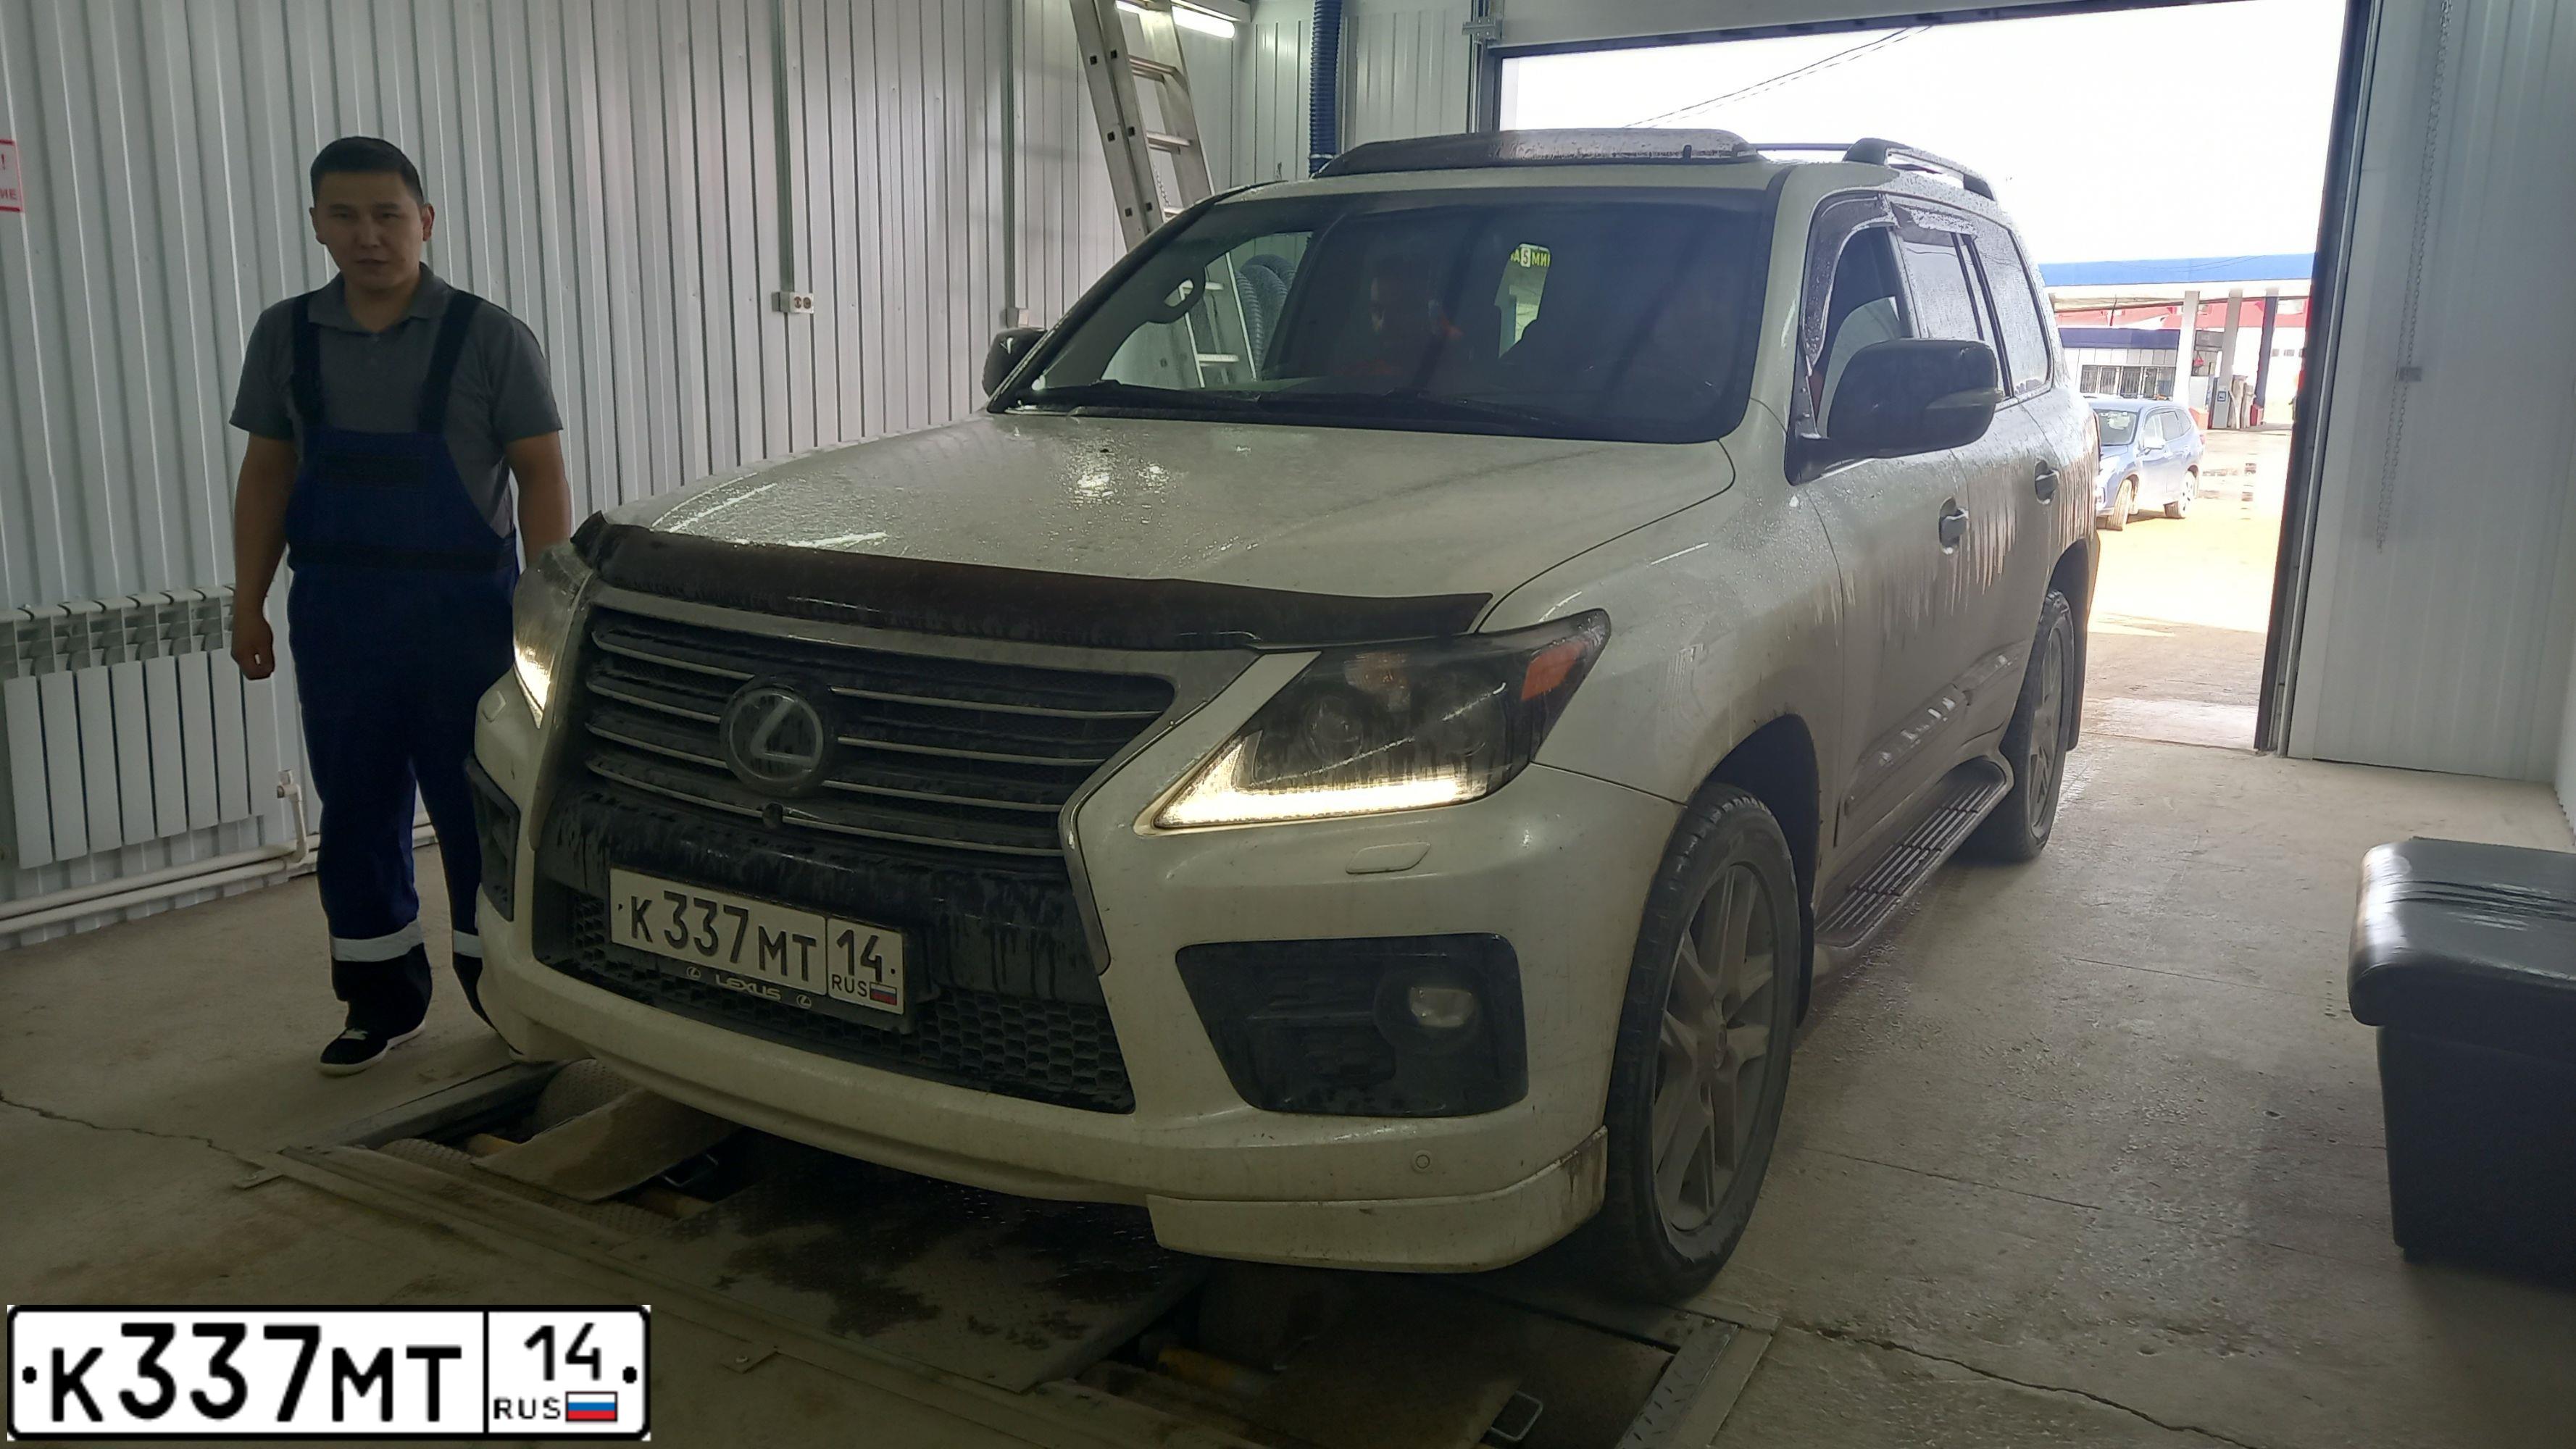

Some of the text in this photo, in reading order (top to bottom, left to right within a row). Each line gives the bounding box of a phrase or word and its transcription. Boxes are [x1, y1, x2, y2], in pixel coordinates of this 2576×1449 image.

[631, 890, 883, 982] К337МТ 14
[715, 974, 781, 1001] LEXUS
[831, 974, 868, 998] RUS
